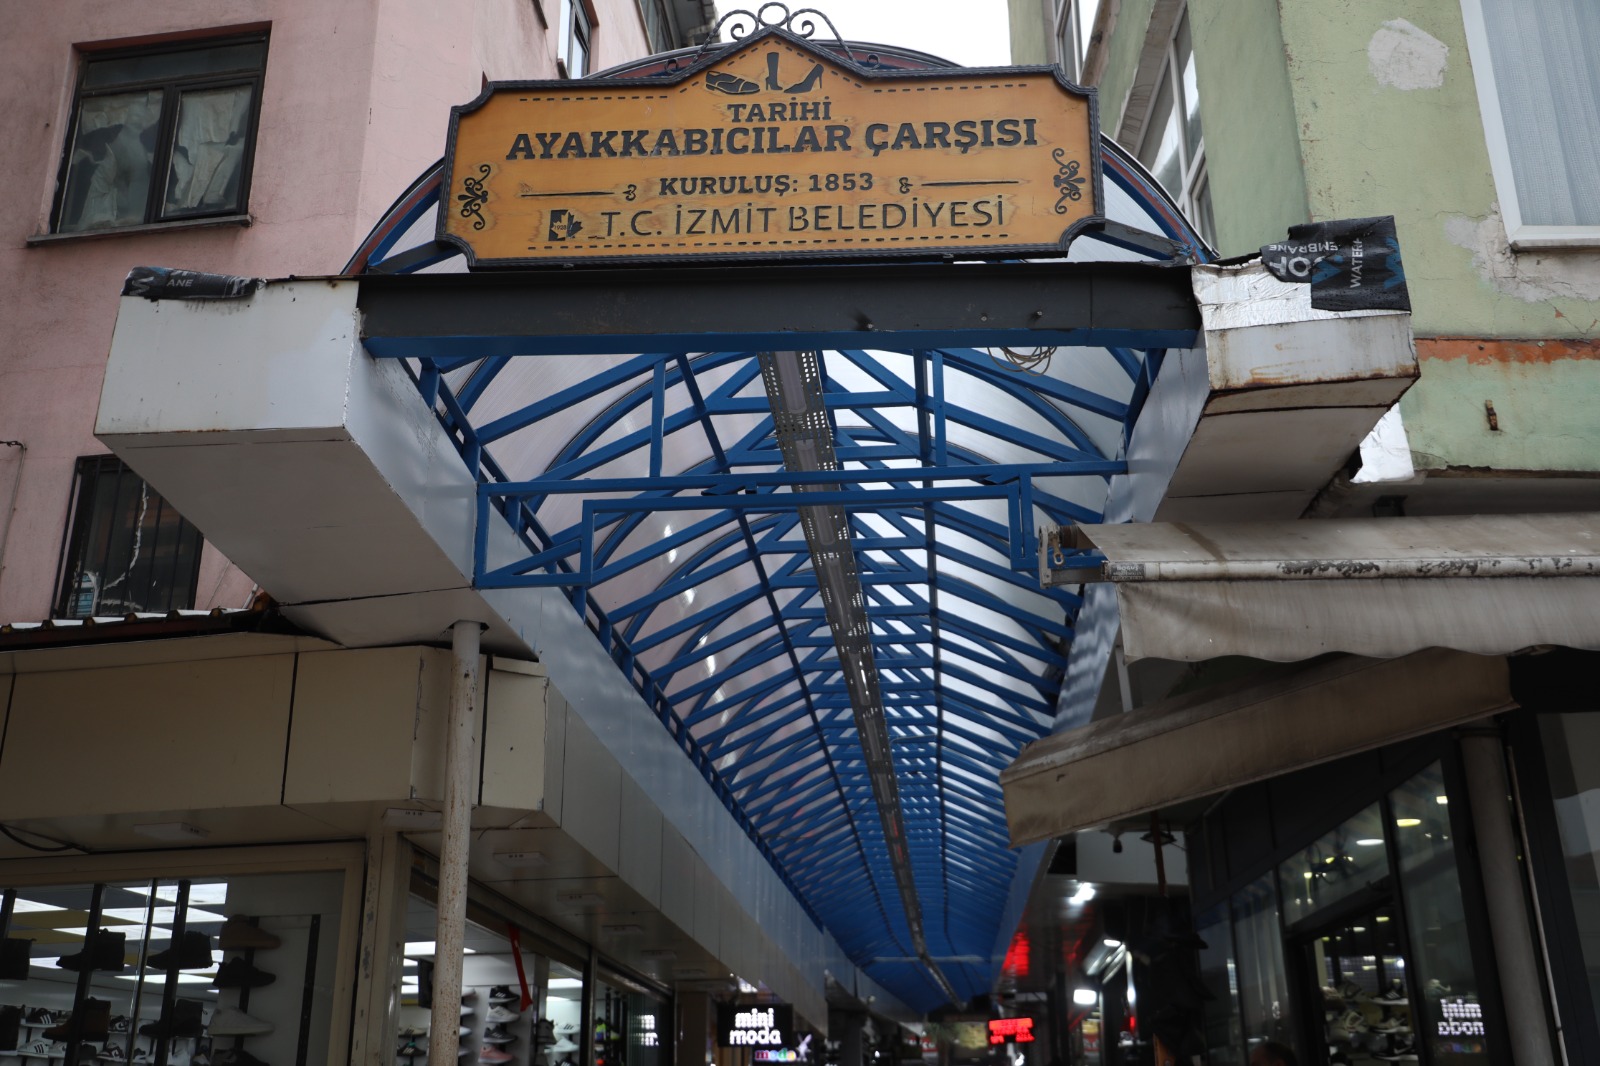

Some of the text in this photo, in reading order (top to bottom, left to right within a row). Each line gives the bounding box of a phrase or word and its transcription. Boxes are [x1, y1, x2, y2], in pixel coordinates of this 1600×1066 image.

[727, 96, 832, 123] TARİHİ
[505, 118, 1038, 160] AYAKKABICILAR ÇARŞISI
[658, 172, 874, 197] KURULUŞ: 1853
[600, 194, 1003, 236] T.C. İZMİT BELEDİYESİ
[735, 1007, 774, 1028] mini
[729, 1026, 782, 1045] moda
[755, 1048, 797, 1062] moda
